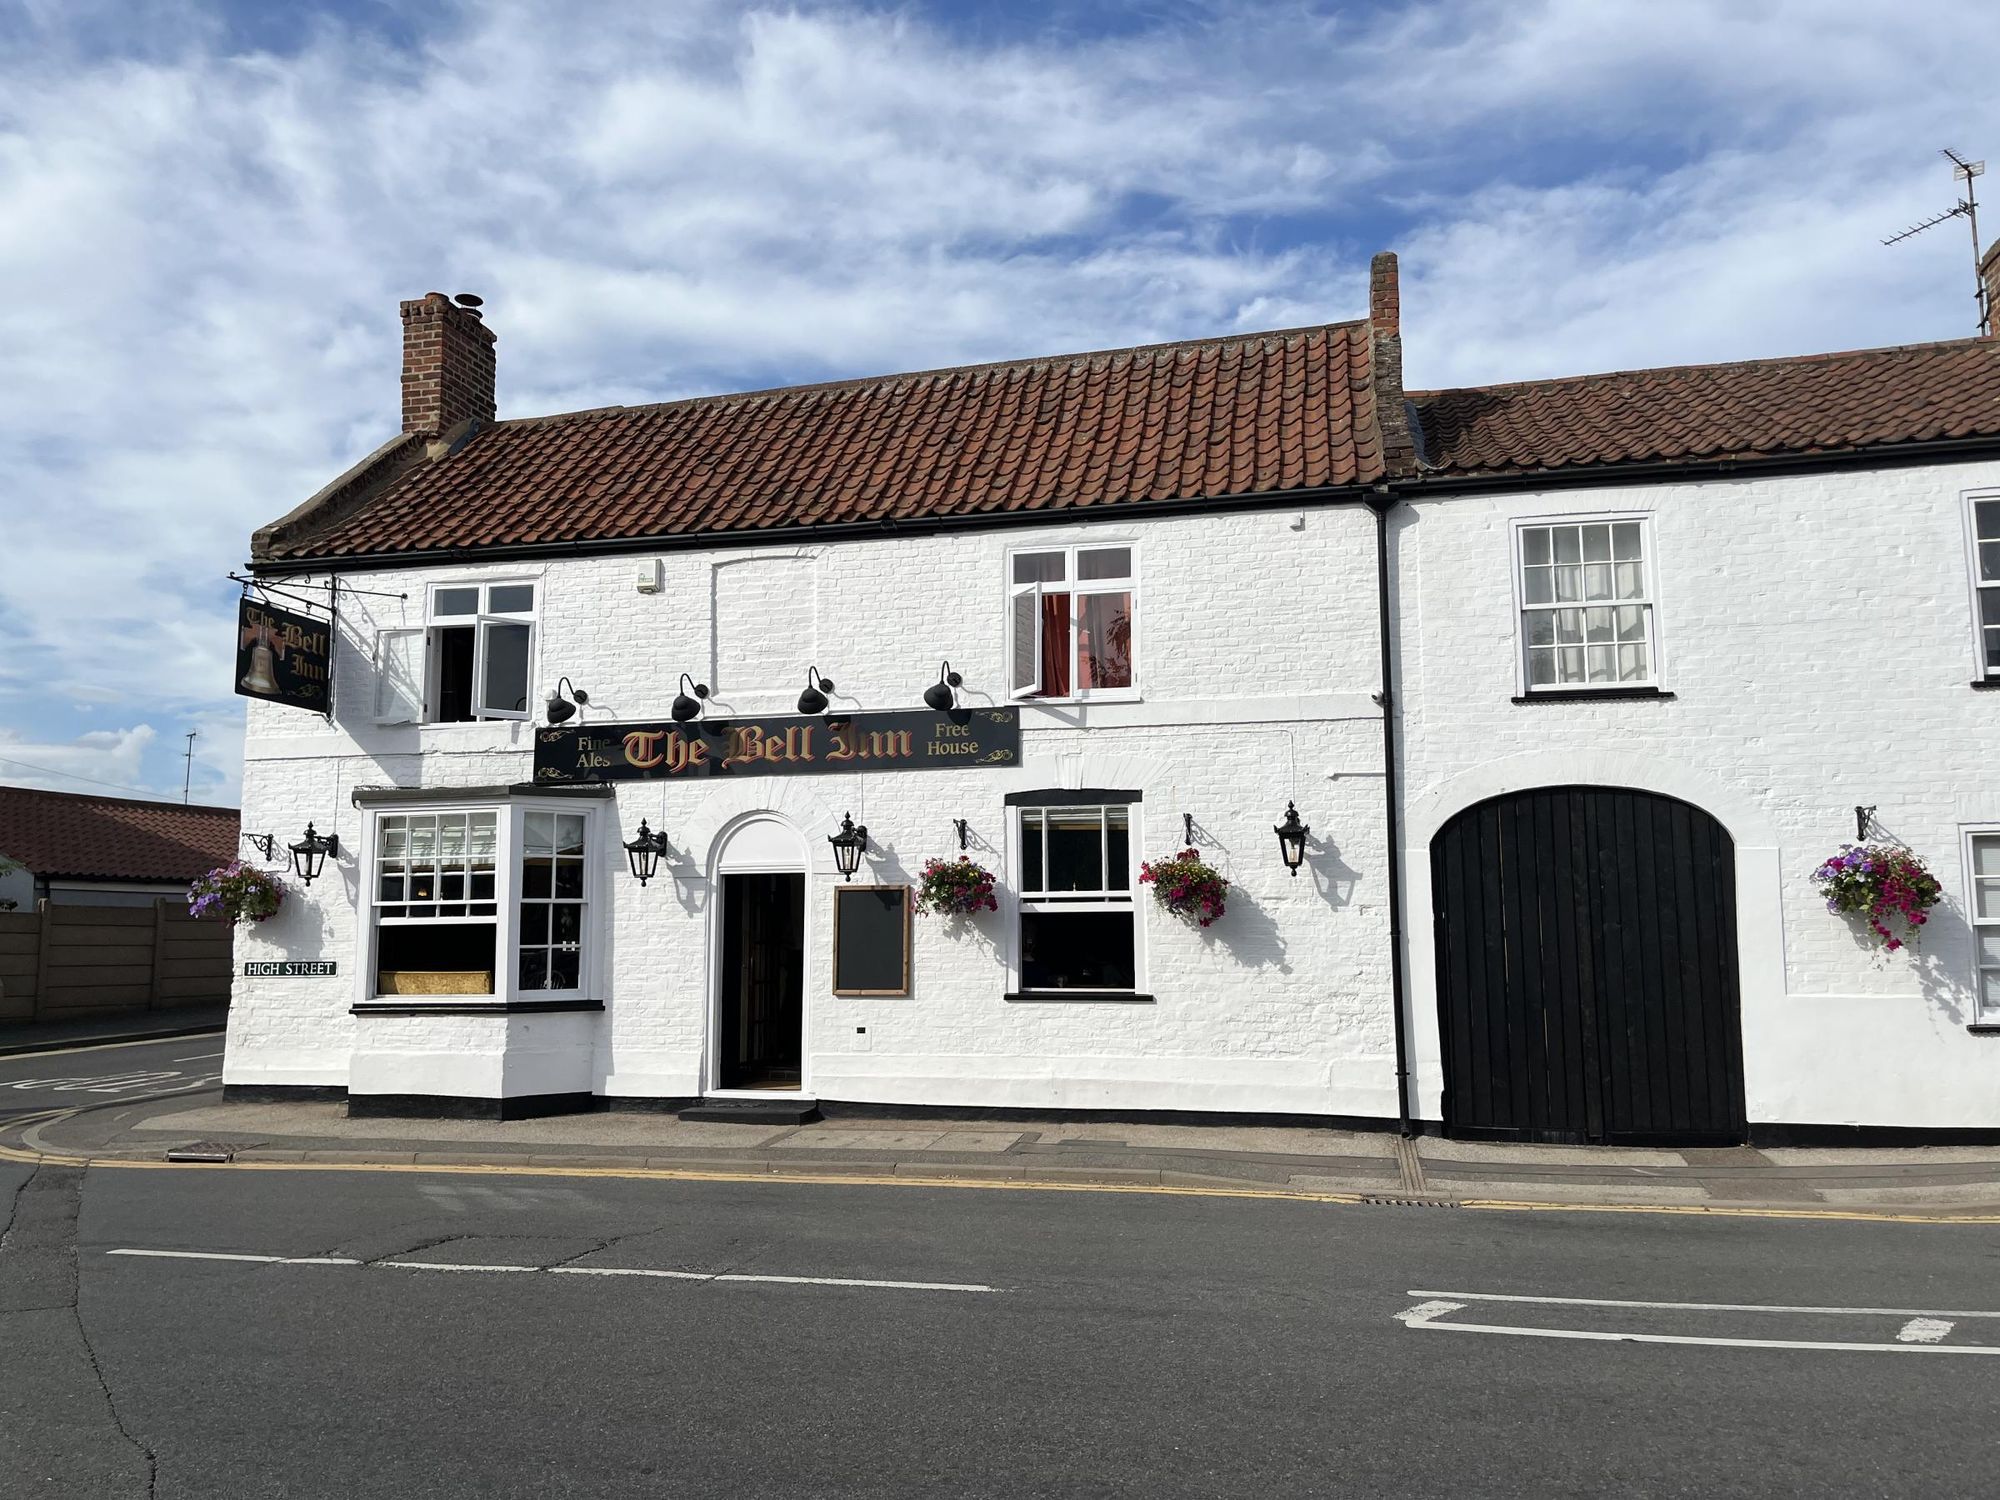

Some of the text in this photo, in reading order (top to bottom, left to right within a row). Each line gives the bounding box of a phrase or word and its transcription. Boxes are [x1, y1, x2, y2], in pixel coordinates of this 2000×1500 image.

[246, 607, 275, 628] The
[282, 622, 326, 656] Bell
[290, 653, 324, 680] Inn
[935, 723, 971, 738] Free
[577, 737, 611, 752] Fine
[622, 721, 914, 774] The Bell Inn
[927, 741, 979, 756] House
[576, 752, 611, 768] Ales
[247, 962, 333, 975] HIGH STREET
